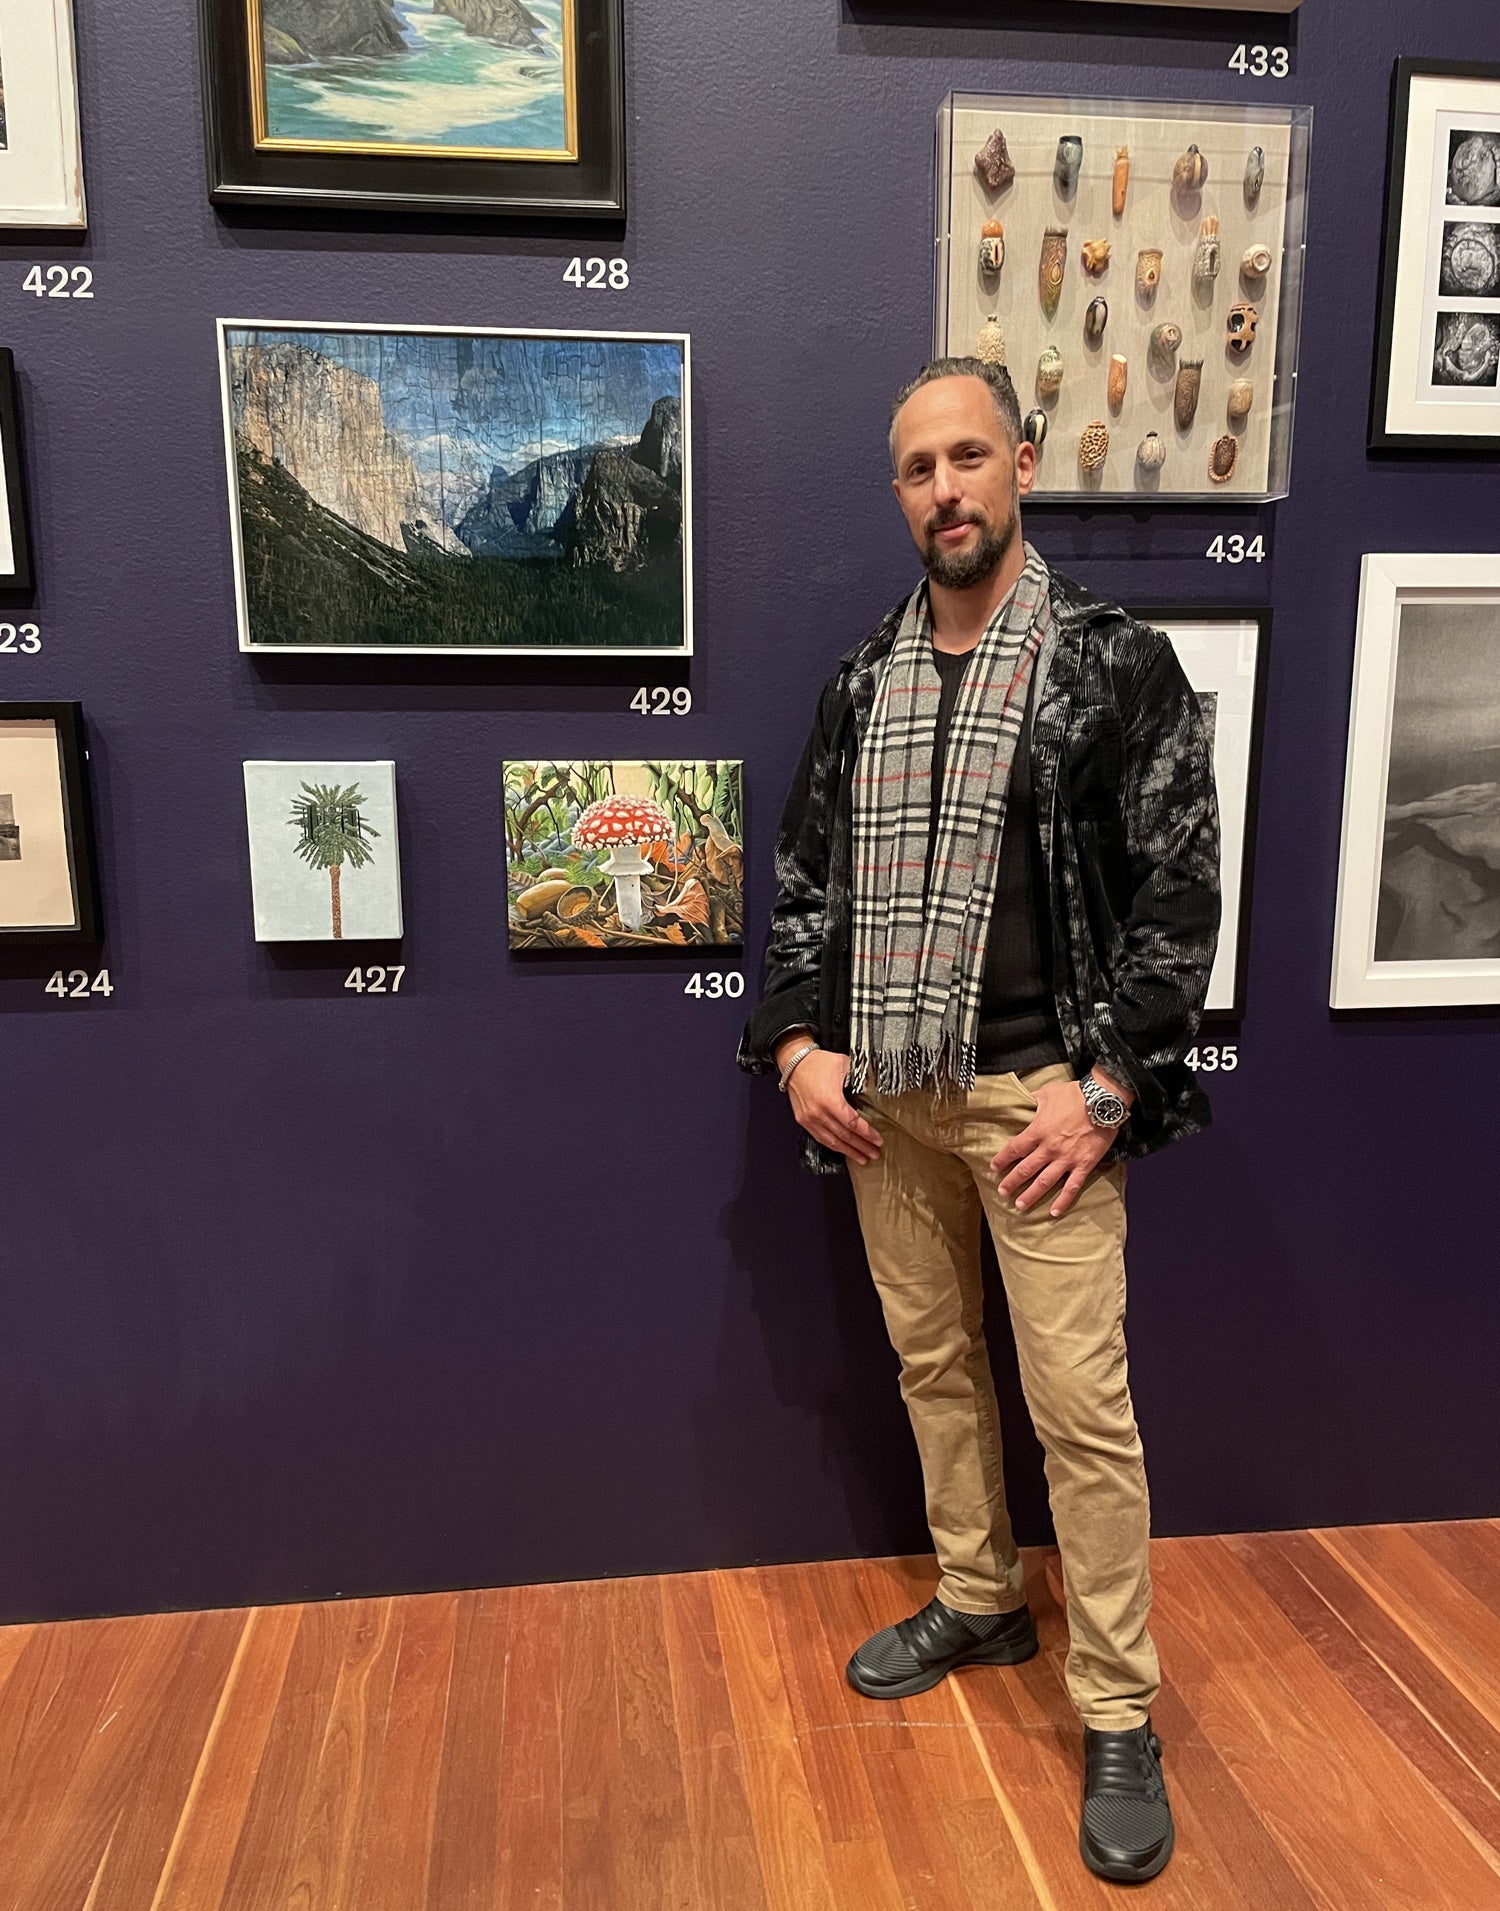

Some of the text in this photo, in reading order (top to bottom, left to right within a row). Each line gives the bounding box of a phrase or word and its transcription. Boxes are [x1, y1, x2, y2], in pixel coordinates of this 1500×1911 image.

[1228, 44, 1289, 78] 433
[22, 265, 95, 299] 422
[562, 257, 630, 290] 428
[1205, 534, 1266, 564] 434
[629, 686, 692, 715] 429
[45, 968, 114, 998] 424
[344, 965, 406, 993] 427
[684, 971, 745, 999] 430
[1183, 1045, 1239, 1072] 435
